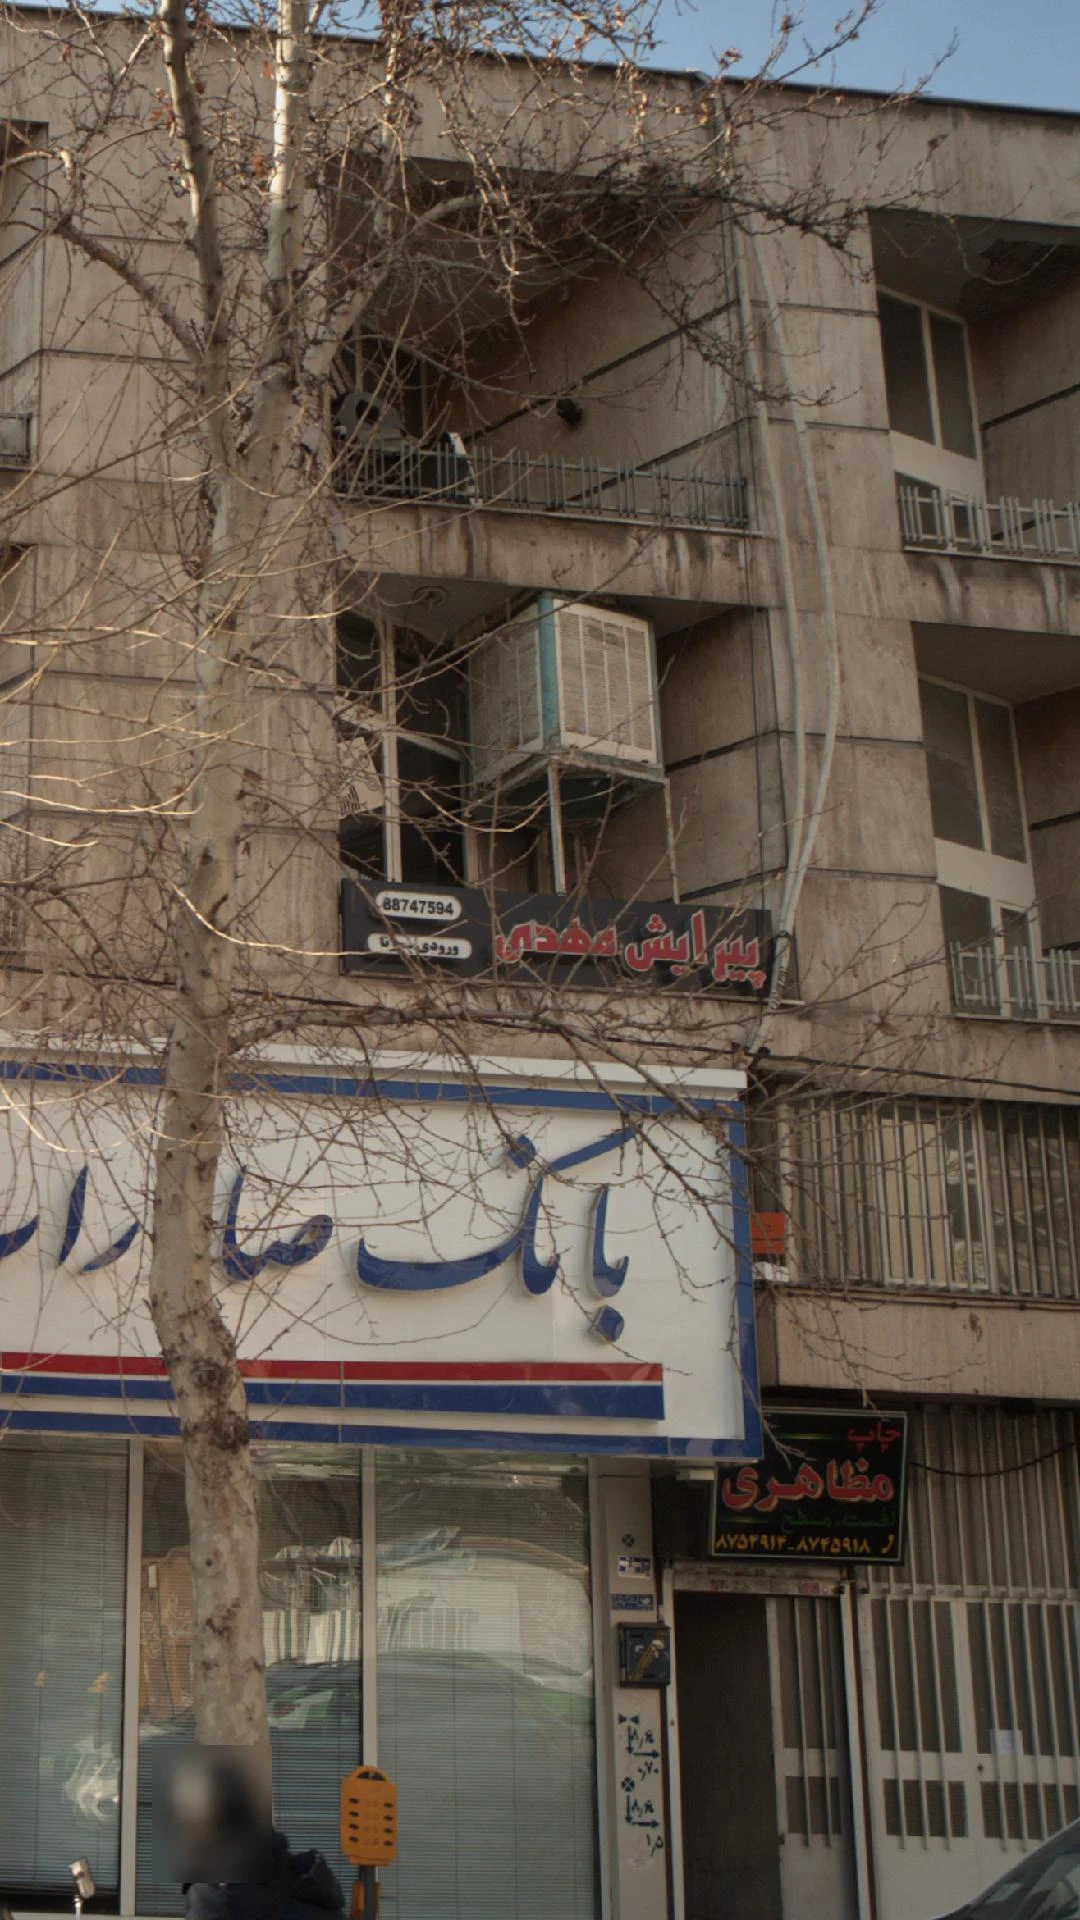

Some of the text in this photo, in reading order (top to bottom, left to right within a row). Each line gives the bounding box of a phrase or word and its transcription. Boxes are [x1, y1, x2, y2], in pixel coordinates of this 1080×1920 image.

[383, 897, 454, 916] 88747594
[495, 909, 766, 989] پیرایش مهدی
[0, 1120, 638, 1344] بانک صارا
[847, 1418, 901, 1454] چاپ
[721, 1458, 895, 1512] مظاهری
